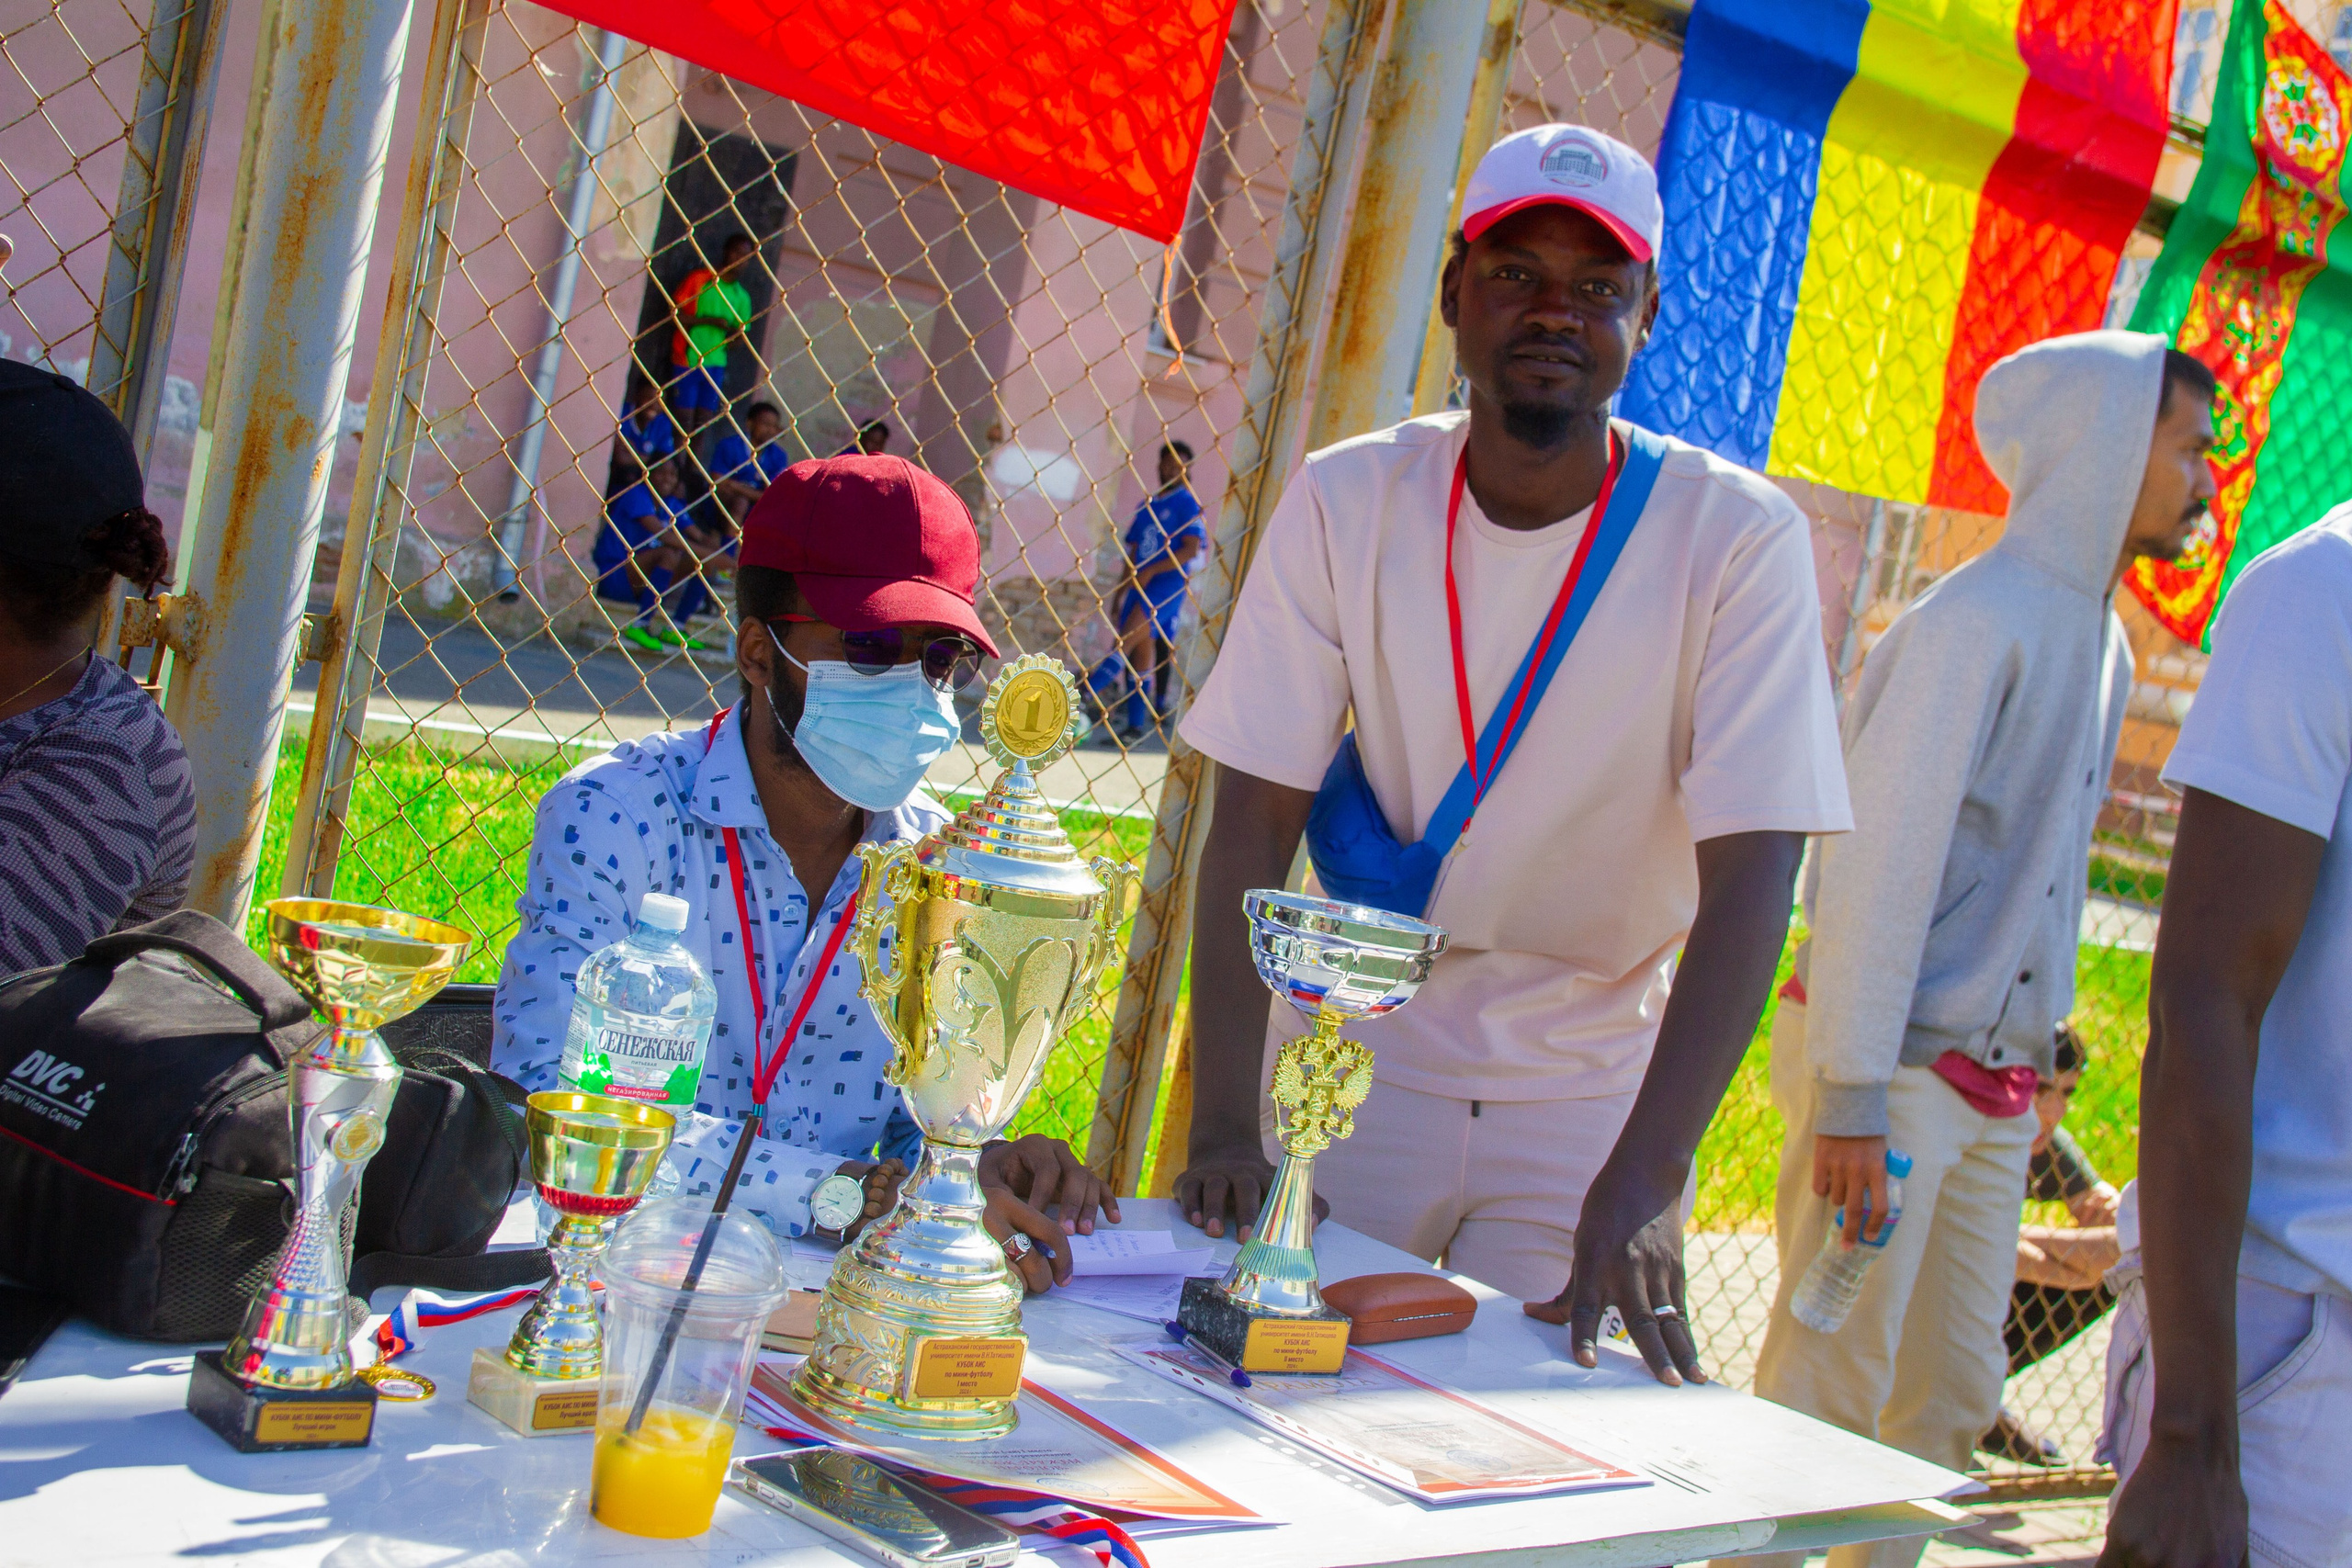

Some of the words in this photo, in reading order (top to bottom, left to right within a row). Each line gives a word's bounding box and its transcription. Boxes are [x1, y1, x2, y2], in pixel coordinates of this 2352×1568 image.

[1020, 691, 1042, 733] 1
[599, 1028, 696, 1062] СЕНЕЖСКАЯ
[10, 1049, 85, 1094] DVC
[0, 1085, 27, 1104] Digital
[24, 1096, 50, 1115] Video
[606, 1086, 668, 1099] НЕГАЗИРОВАННАЯ
[1281, 1348, 1317, 1356] мини-футболу
[543, 1403, 560, 1411] КУБОК
